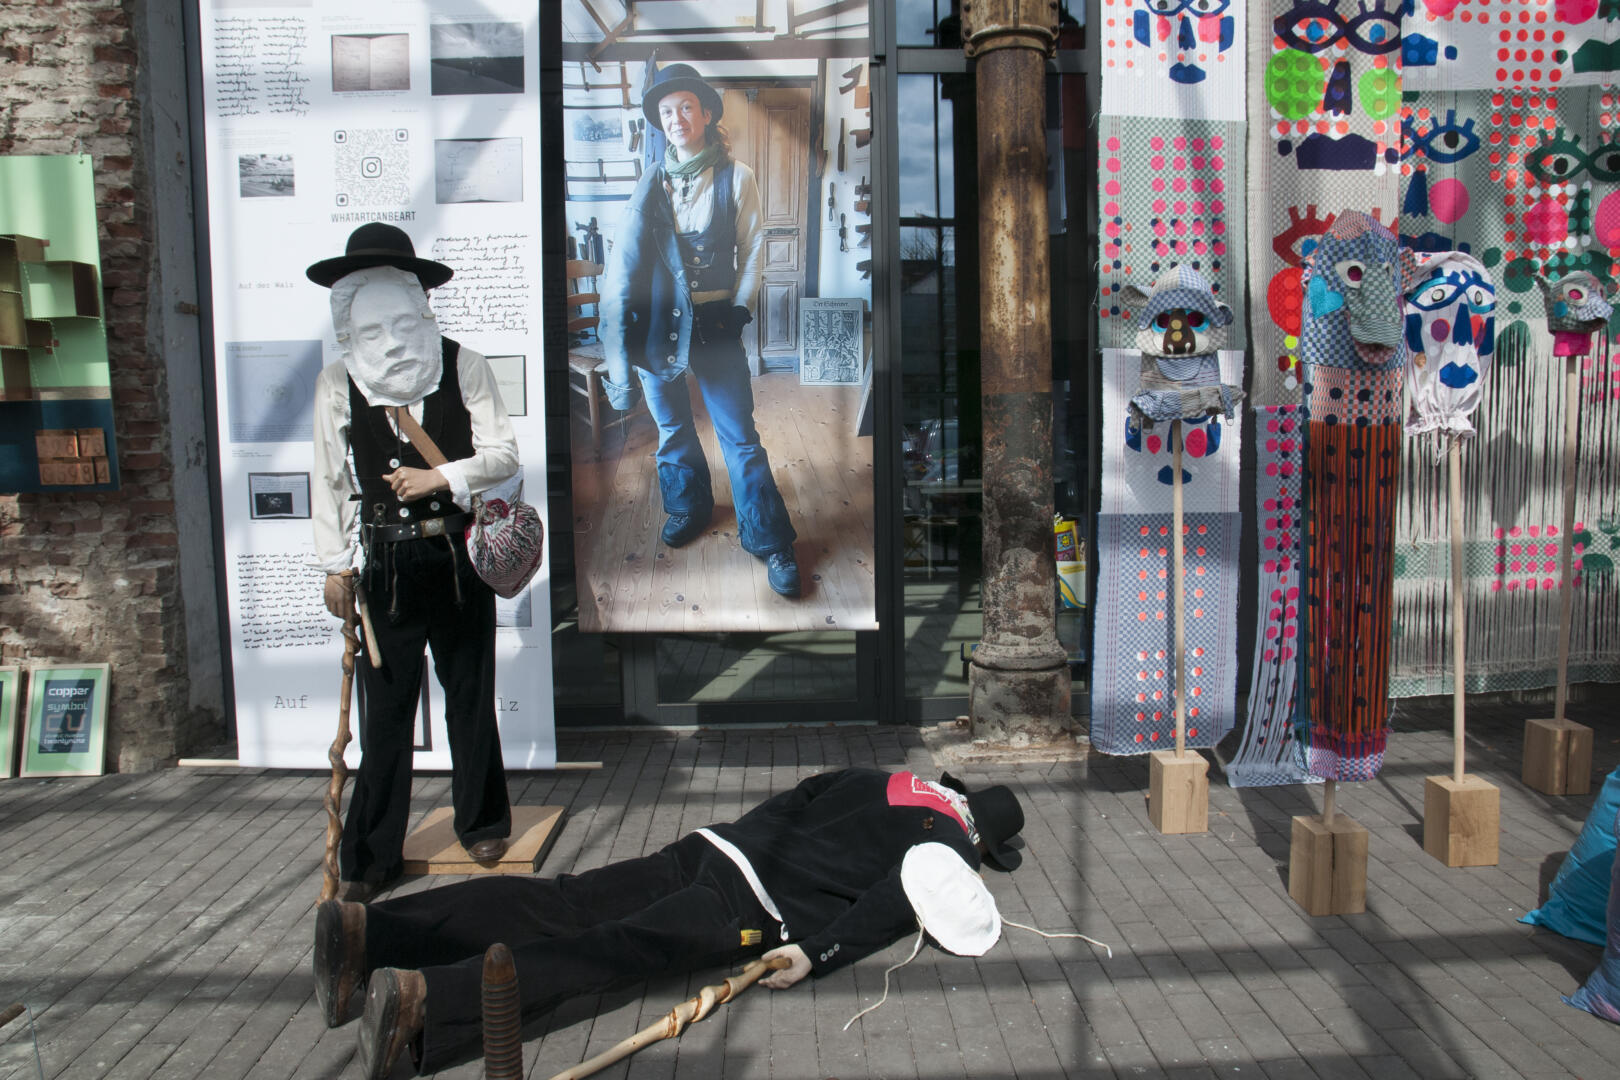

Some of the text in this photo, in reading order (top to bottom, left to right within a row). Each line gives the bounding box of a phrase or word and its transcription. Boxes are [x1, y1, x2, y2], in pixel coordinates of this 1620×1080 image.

[331, 211, 417, 223] WHATARTCANBEART
[48, 687, 90, 698] copper
[274, 695, 308, 709] Auf
